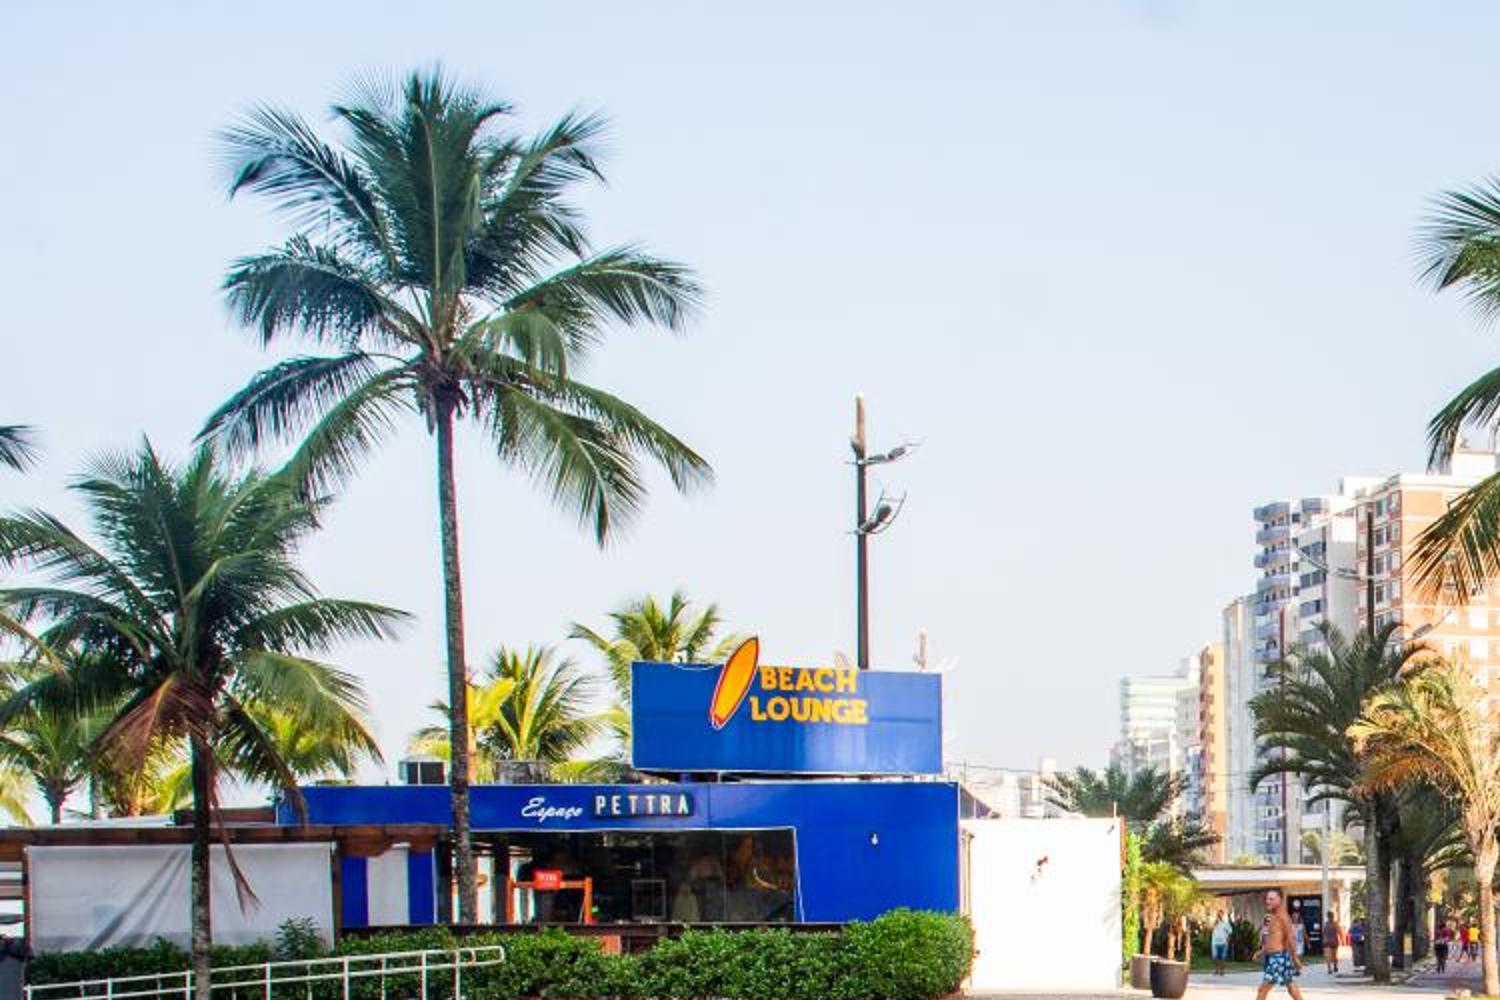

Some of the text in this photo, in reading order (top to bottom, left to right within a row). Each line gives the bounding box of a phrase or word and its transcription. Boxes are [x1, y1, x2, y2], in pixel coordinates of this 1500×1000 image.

[760, 666, 857, 693] BEACH
[750, 696, 868, 724] LOUNGE
[521, 795, 689, 823] Espaço PETTRA
